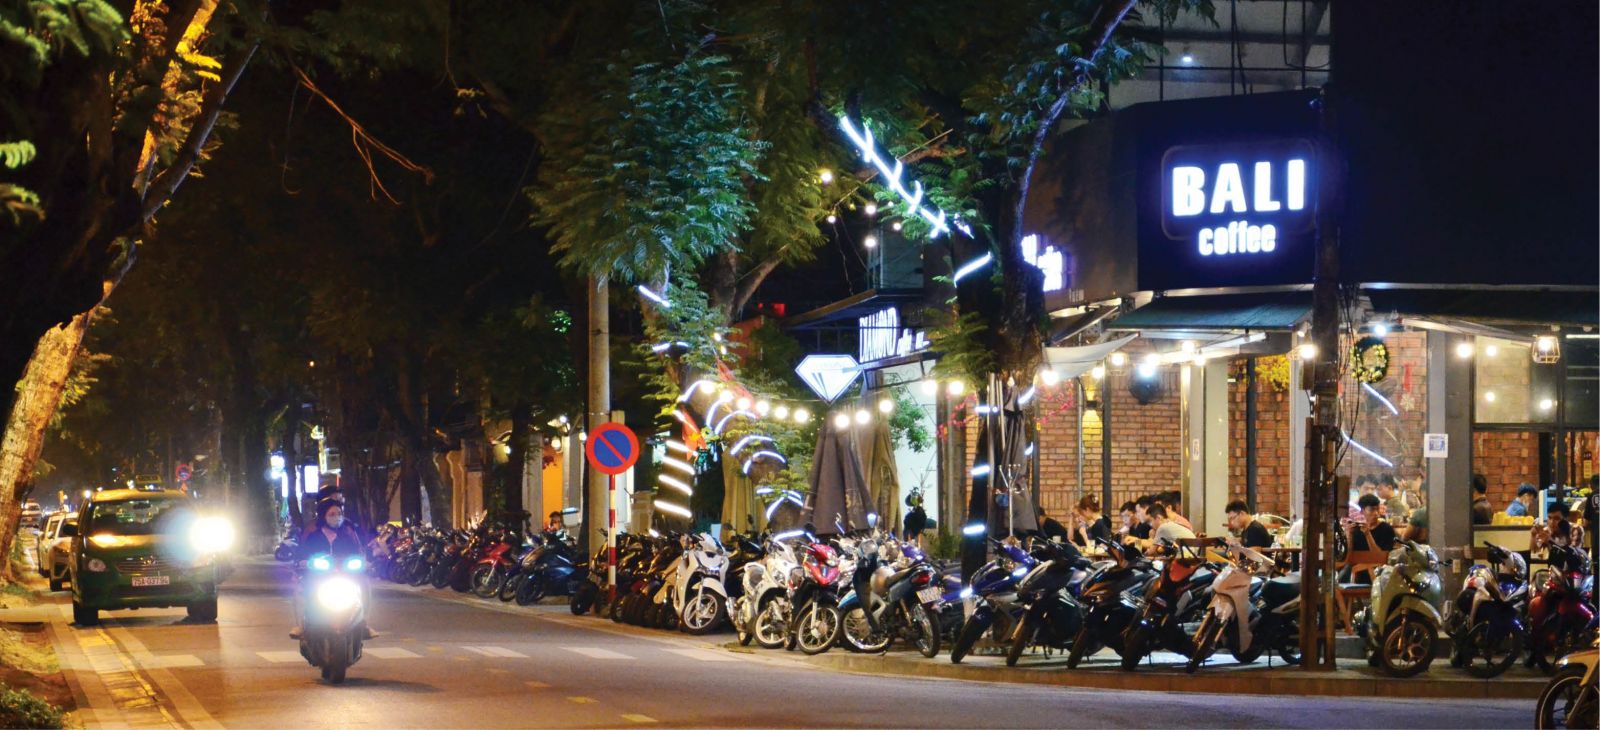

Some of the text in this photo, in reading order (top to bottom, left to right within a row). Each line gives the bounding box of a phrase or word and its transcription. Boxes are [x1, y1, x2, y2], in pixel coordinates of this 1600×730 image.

[1172, 158, 1305, 217] BALI
[1198, 220, 1276, 256] coffee
[859, 307, 898, 364] DIAMOND
